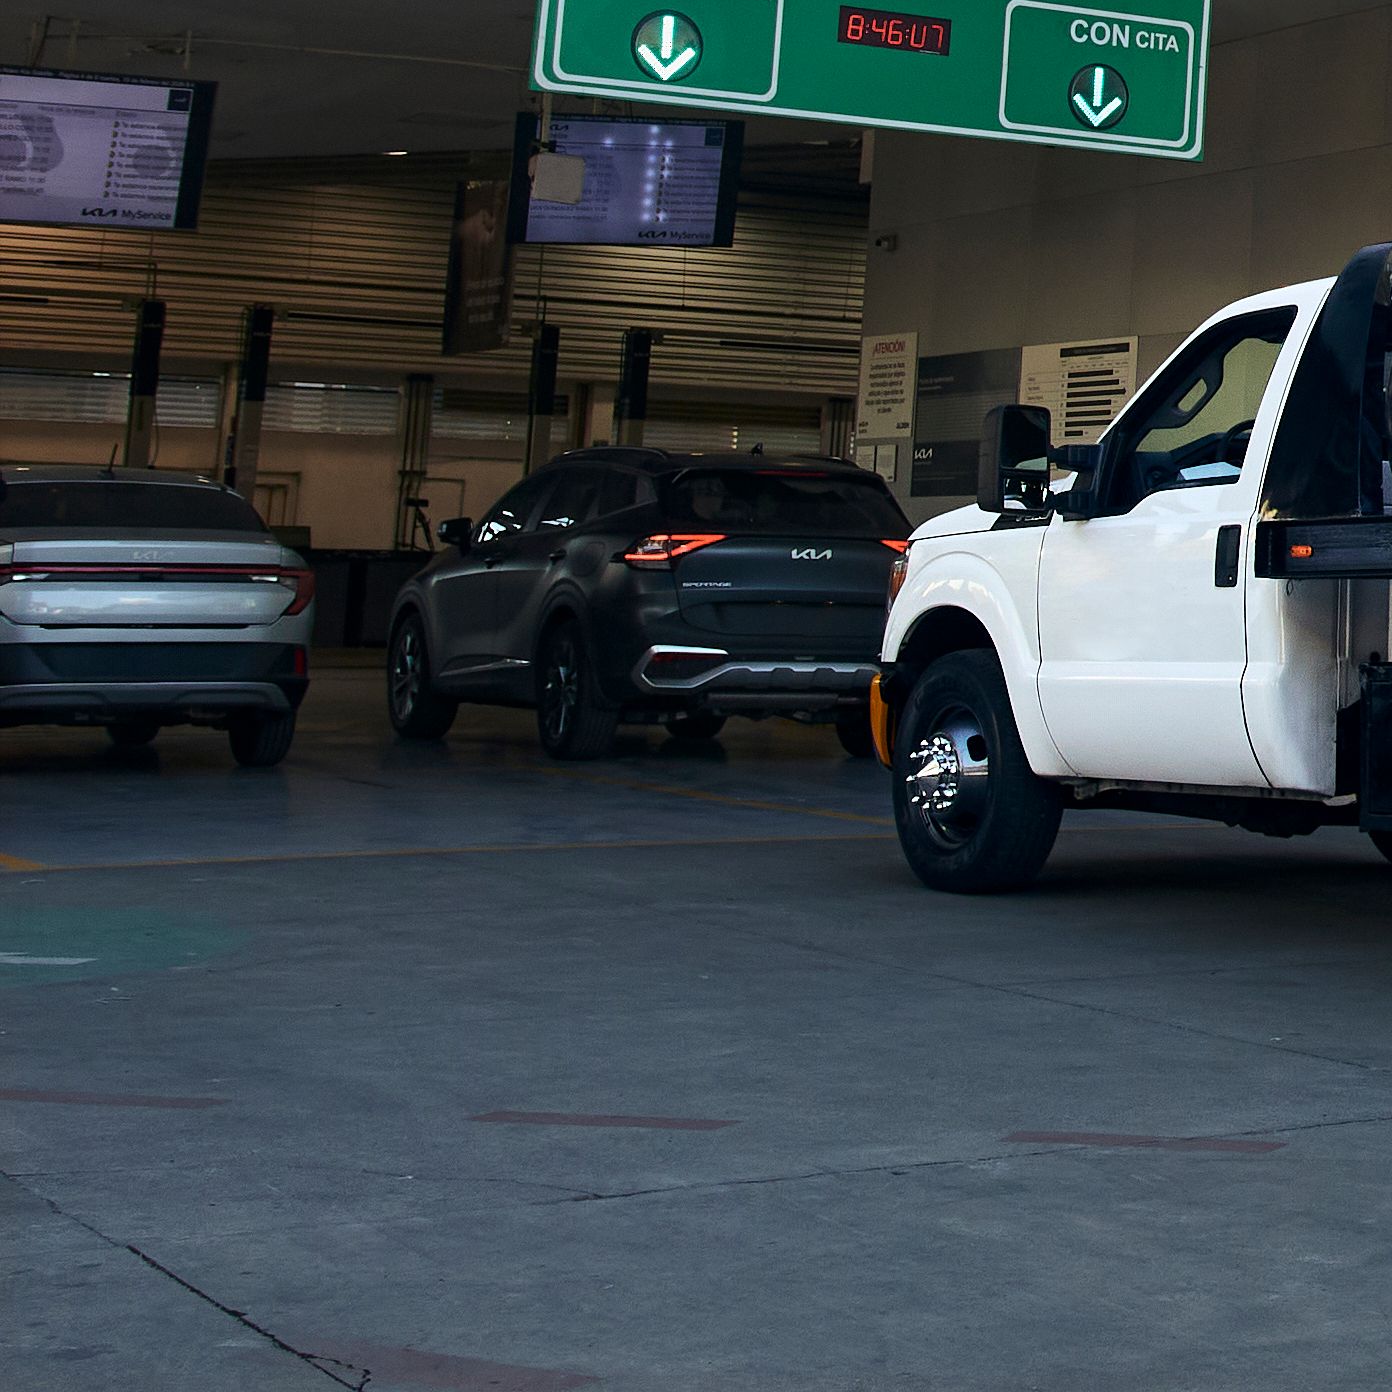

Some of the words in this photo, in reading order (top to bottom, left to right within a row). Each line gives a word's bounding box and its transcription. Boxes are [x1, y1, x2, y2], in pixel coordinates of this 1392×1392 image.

[1070, 19, 1130, 48] CON
[1135, 30, 1180, 53] CITA
[121, 210, 172, 221] MyService
[791, 548, 833, 560] KIA
